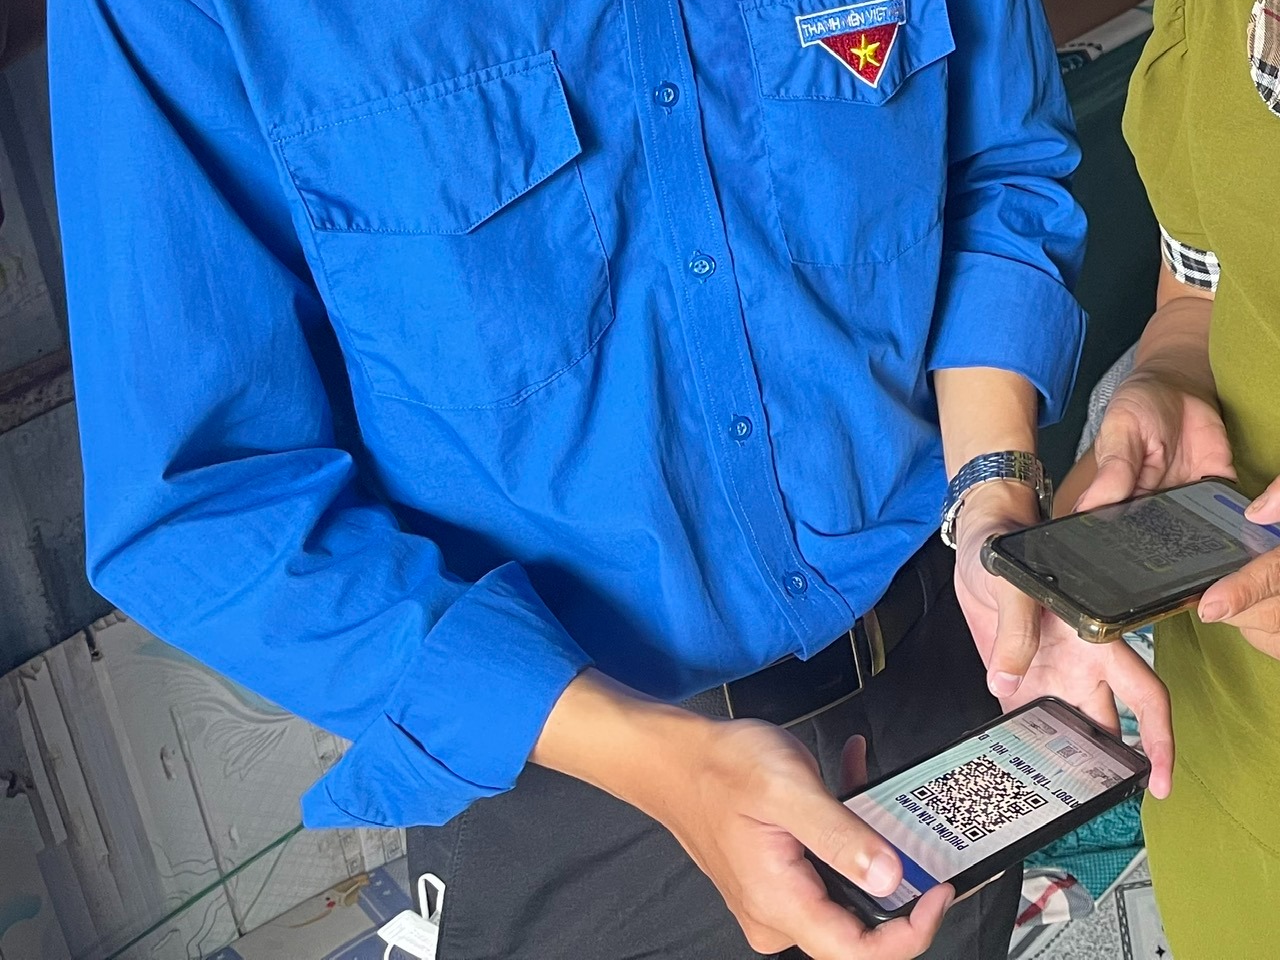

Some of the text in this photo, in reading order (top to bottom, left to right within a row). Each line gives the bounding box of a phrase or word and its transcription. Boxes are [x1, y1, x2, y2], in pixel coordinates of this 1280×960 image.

[802, 17, 840, 37] THANH
[1009, 756, 1037, 776] HƯNG
[895, 794, 969, 851] PHƯỜNG TÂN HƯNG
